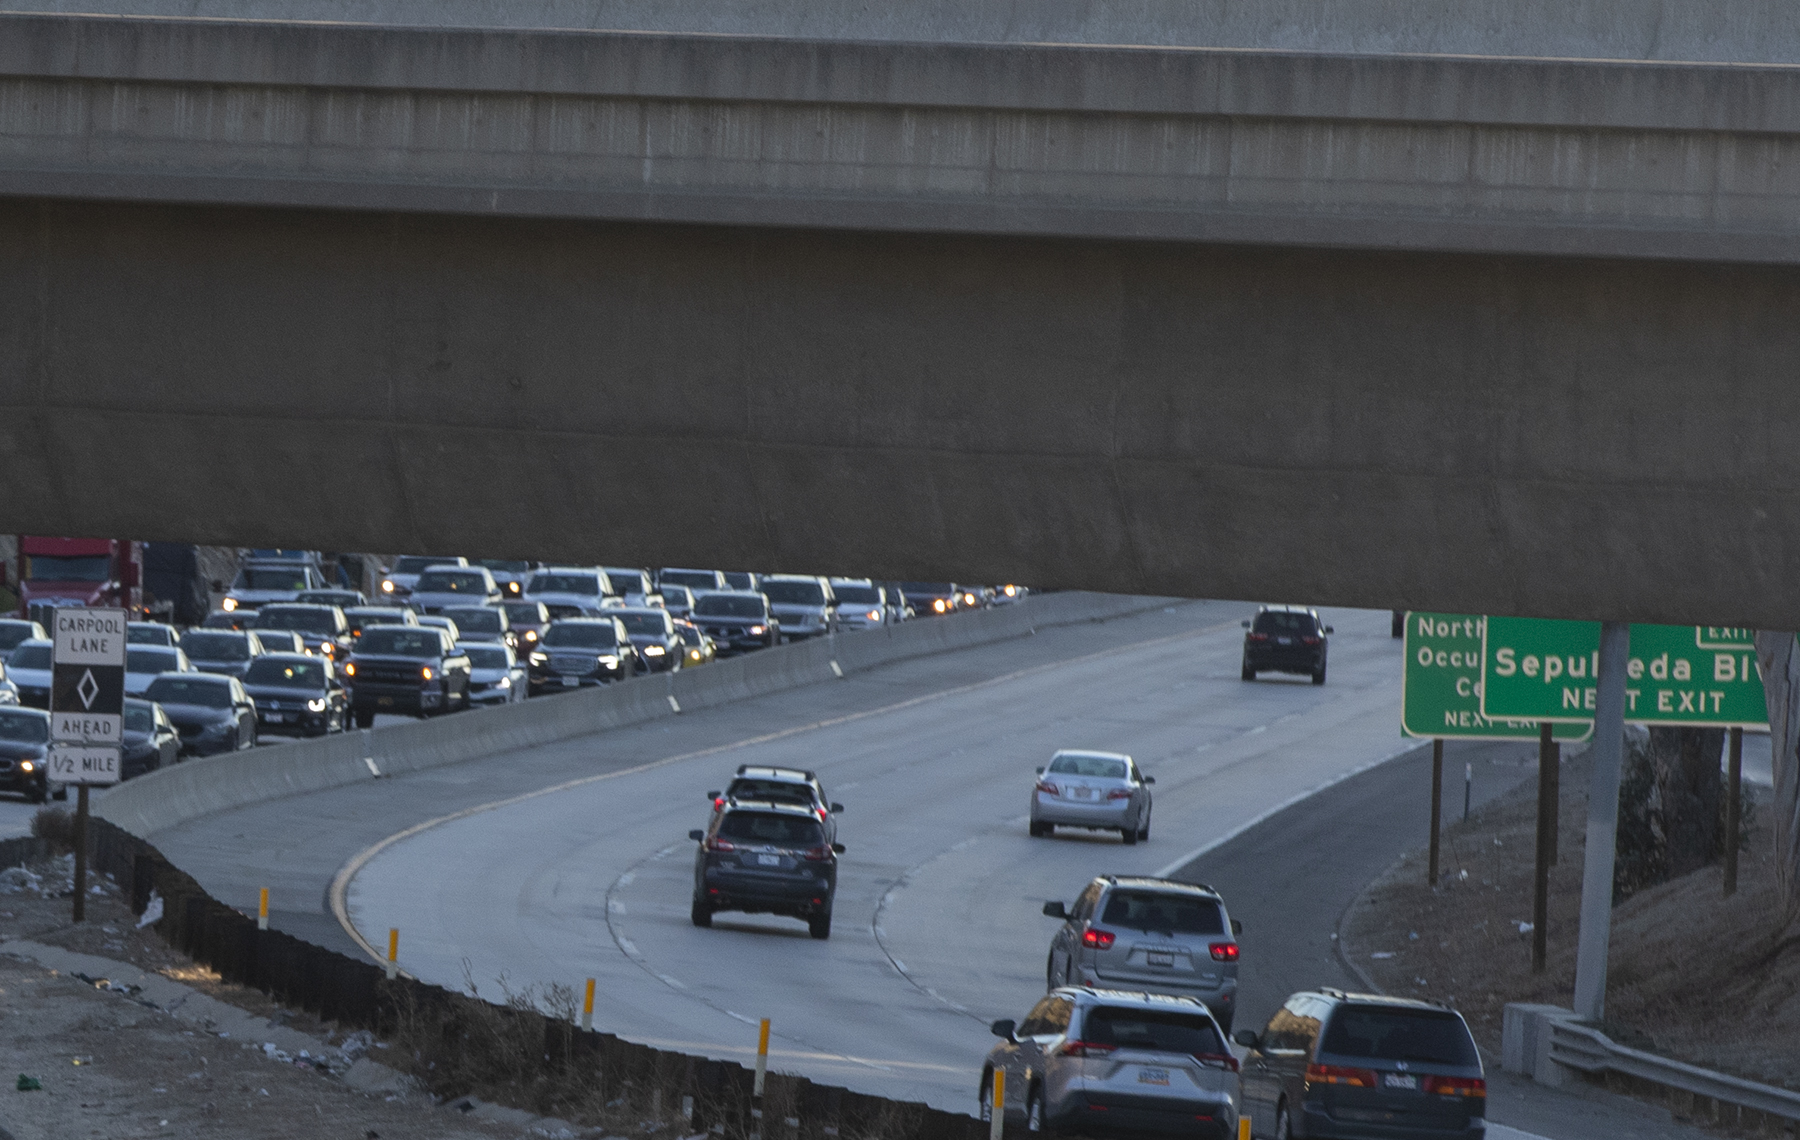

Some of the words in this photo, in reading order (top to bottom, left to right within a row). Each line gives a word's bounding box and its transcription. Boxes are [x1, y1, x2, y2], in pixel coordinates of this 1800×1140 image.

[58, 617, 122, 634] CARPOOL
[70, 638, 109, 653] LANE
[1417, 646, 1478, 668] Occu
[1495, 647, 1691, 684] Sepuleda
[1714, 653, 1763, 682] Bl
[1562, 686, 1641, 712] NET
[1657, 689, 1725, 713] EXIT
[61, 720, 111, 735] AHEAD
[53, 754, 74, 773] 1/2
[82, 758, 115, 772] MILE
